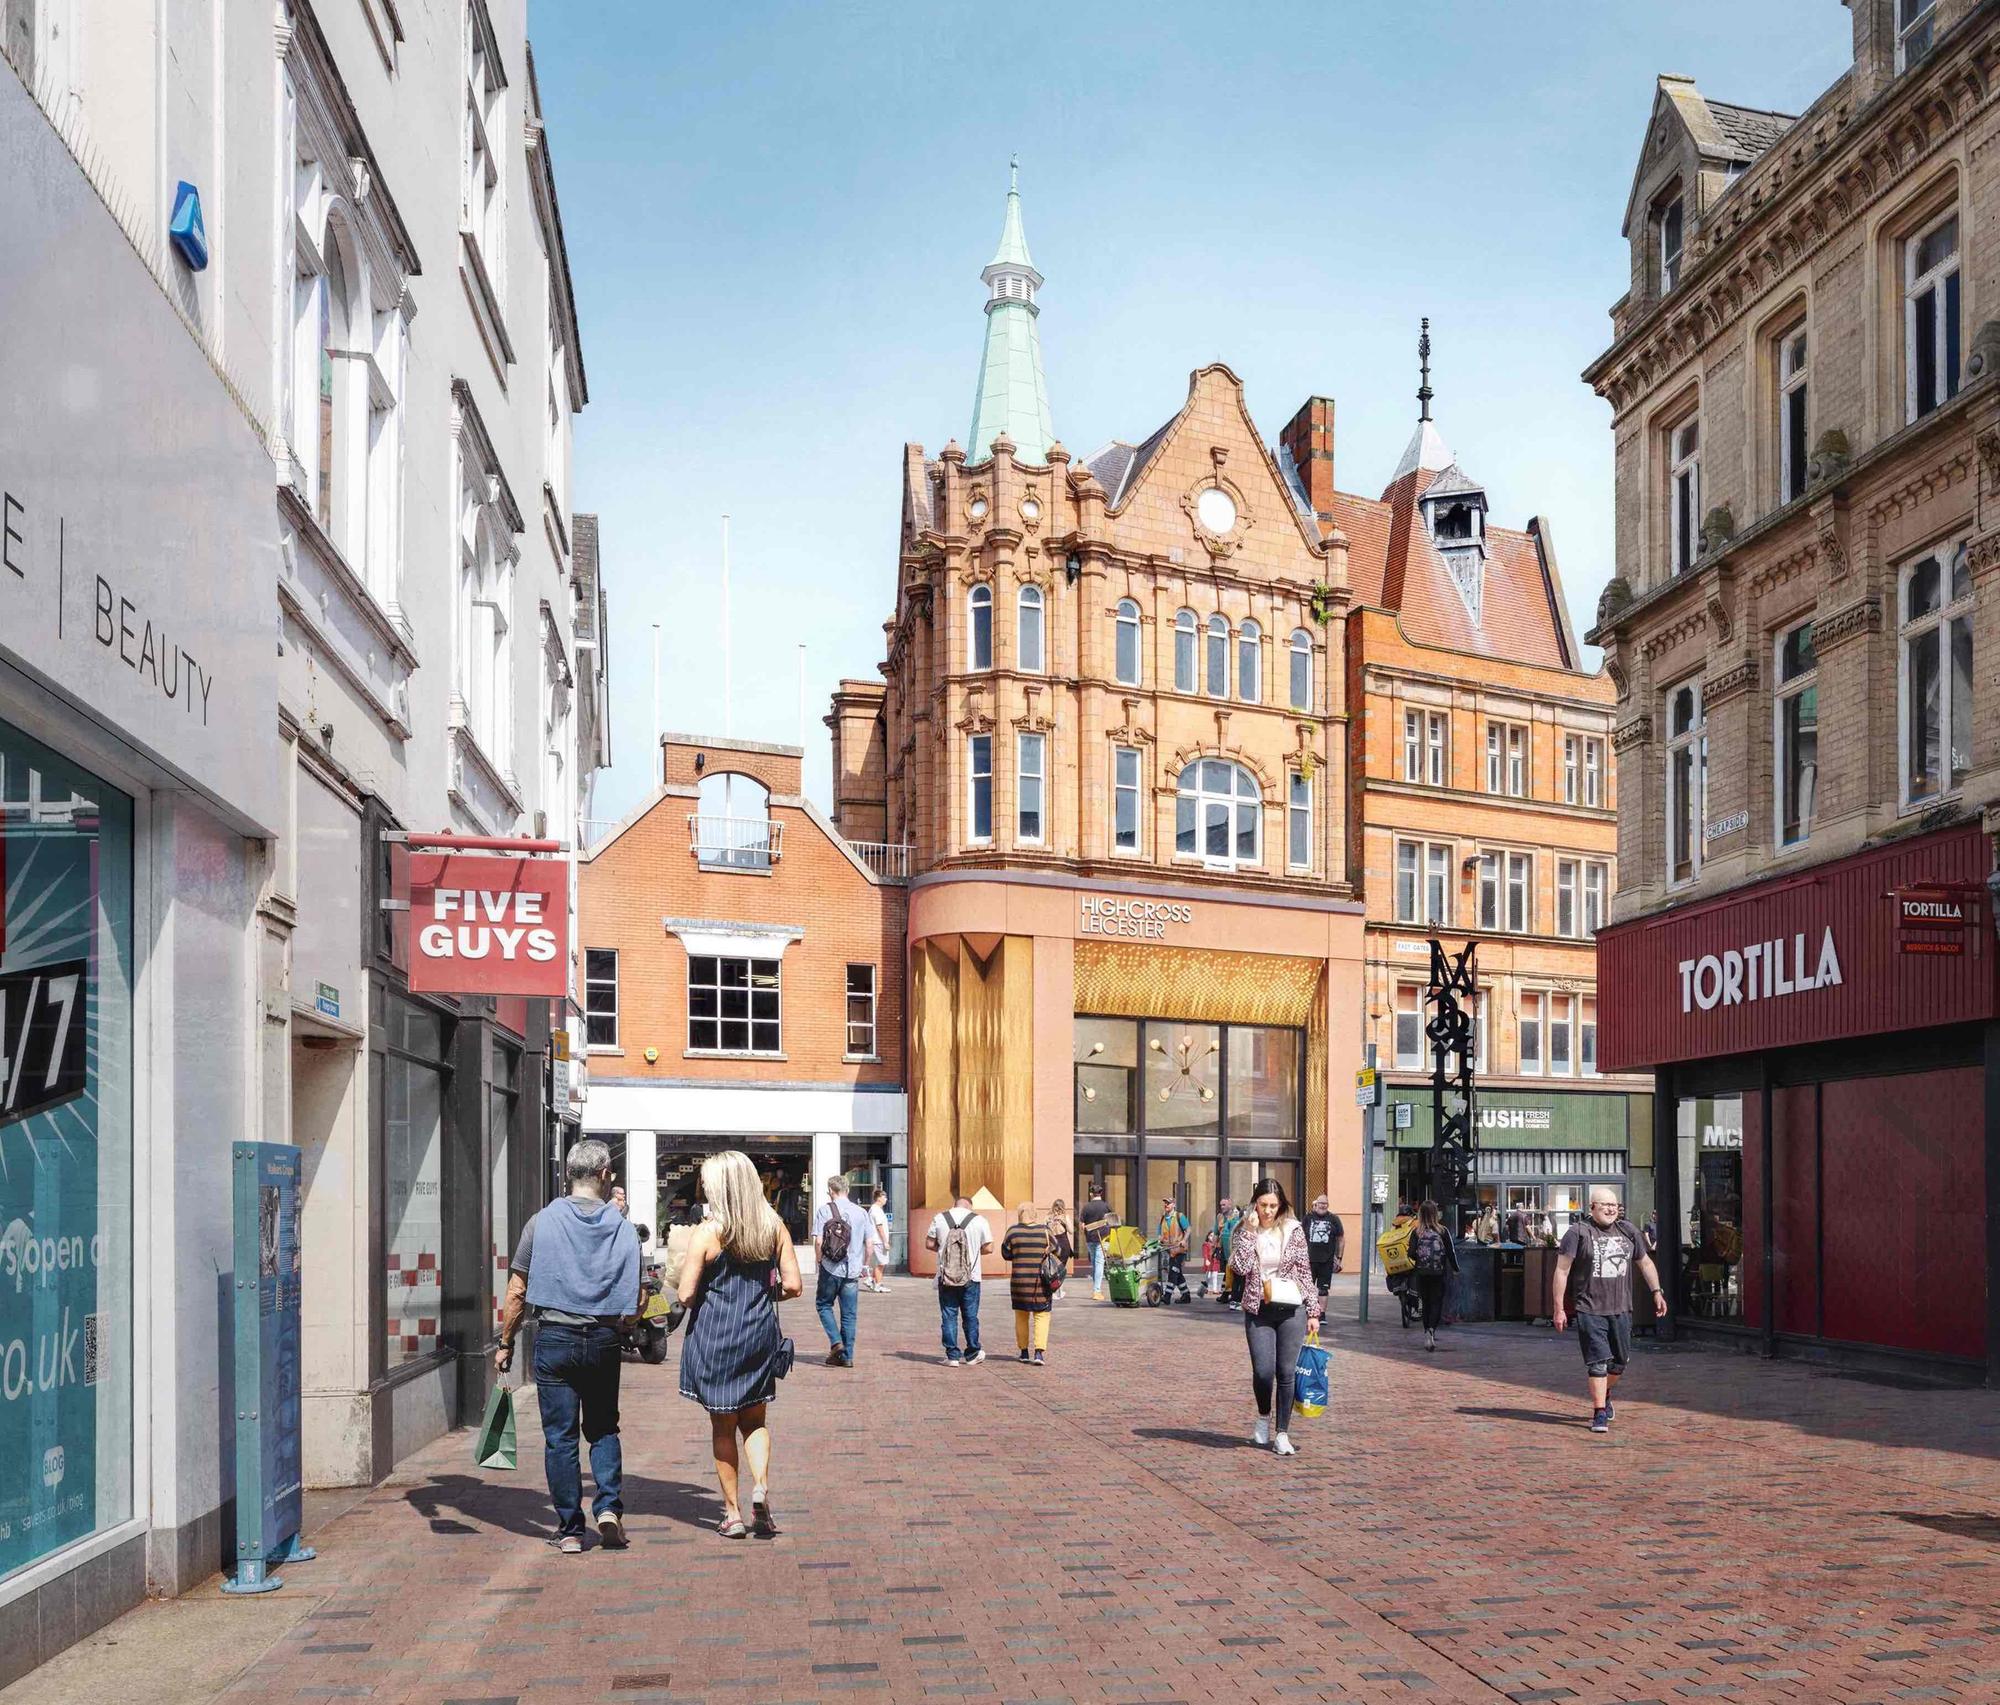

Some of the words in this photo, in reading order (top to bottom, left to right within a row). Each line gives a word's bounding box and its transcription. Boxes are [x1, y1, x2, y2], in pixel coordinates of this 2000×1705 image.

[4, 491, 25, 579] E
[96, 574, 213, 726] BEAUTY
[1708, 814, 1745, 838] CHEAPSIDE
[434, 888, 544, 924] FIVE
[1081, 896, 1192, 923] HIGHCROSS
[1902, 902, 1962, 918] TORTILLA
[1081, 914, 1165, 939] LEICESTER
[419, 925, 557, 962] GUYS
[1679, 925, 1844, 1014] TORTILLA
[1525, 1111, 1550, 1119] FRESH
[25, 1234, 84, 1288] open
[0, 1306, 78, 1401] o.uk
[44, 1454, 64, 1475] BLOG
